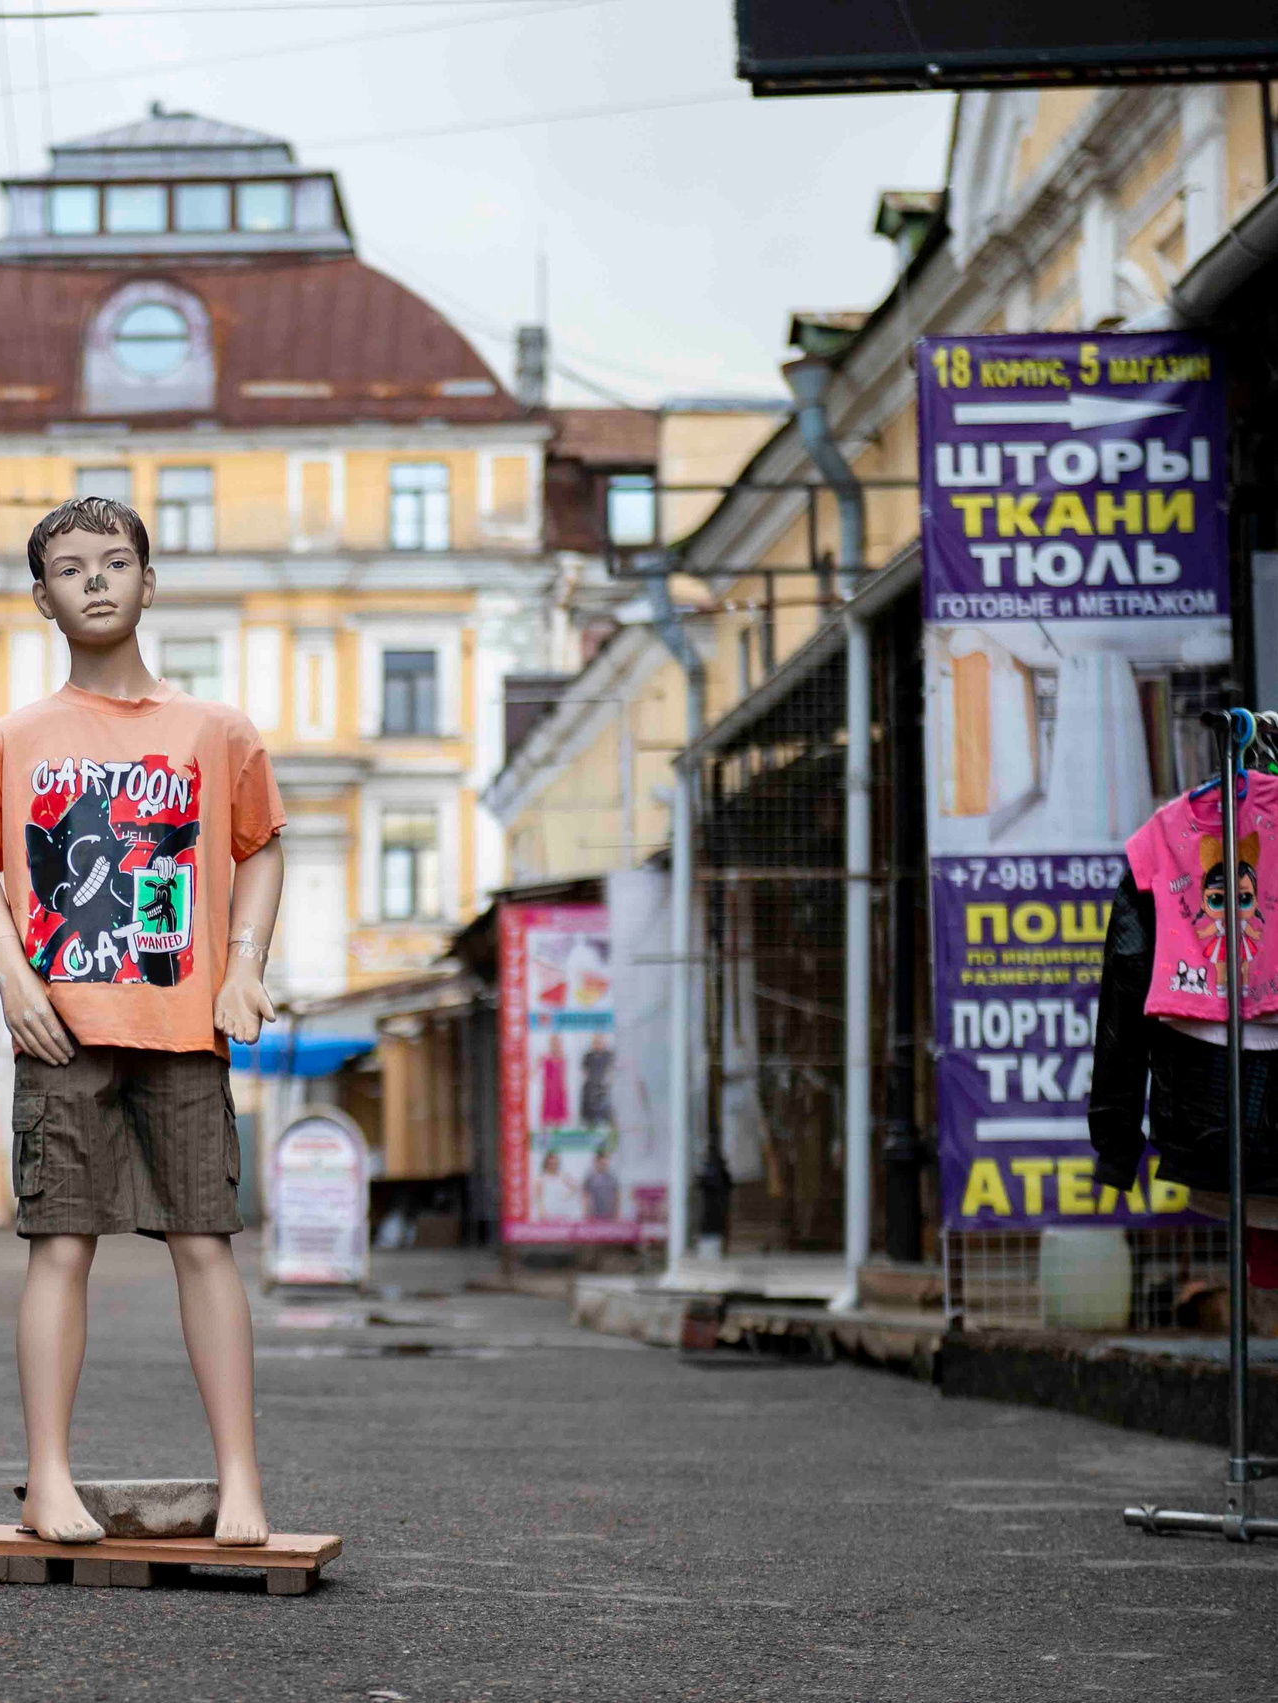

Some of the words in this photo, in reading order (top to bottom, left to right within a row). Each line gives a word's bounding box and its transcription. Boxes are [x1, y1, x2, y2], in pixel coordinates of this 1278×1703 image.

[932, 346, 971, 388] 18
[979, 359, 1070, 390] КОРПУС,
[1079, 343, 1100, 386] 5
[1107, 355, 1211, 384] МАГАЗИН
[934, 437, 1211, 487] ШТОРЫ
[949, 490, 1196, 538] ТКАНИ
[968, 540, 1181, 587] ТЮЛЬ
[935, 592, 1054, 618] ГОТОВЫЕ
[1076, 589, 1217, 617] МЕТРАЖОМ
[31, 757, 188, 814] CARTOON
[63, 921, 143, 977] CAT
[136, 933, 183, 950] WANTED
[966, 948, 996, 966] ПО
[960, 967, 1070, 986] РАЗМЕРАМ
